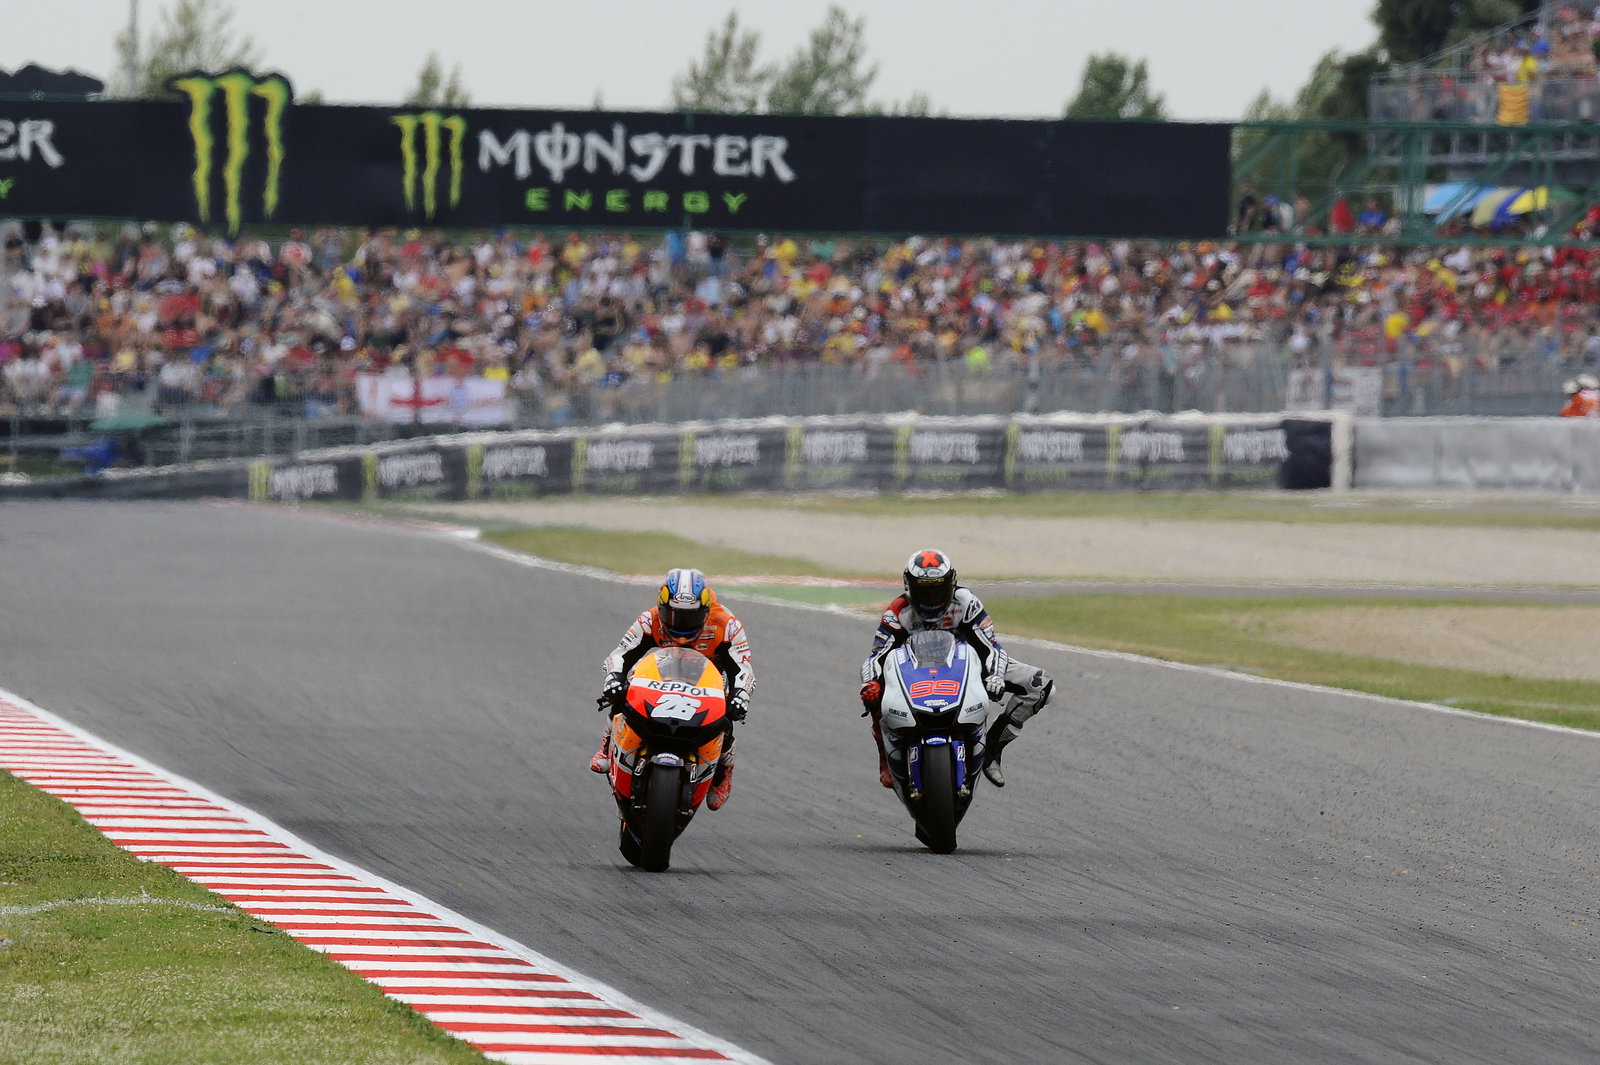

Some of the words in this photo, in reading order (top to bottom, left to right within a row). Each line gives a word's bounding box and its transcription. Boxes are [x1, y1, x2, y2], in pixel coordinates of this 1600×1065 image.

[477, 122, 797, 183] MONSTER
[524, 187, 748, 213] ENERGY
[648, 681, 711, 697] REPSOL
[910, 680, 960, 698] 99
[651, 693, 702, 721] 26
